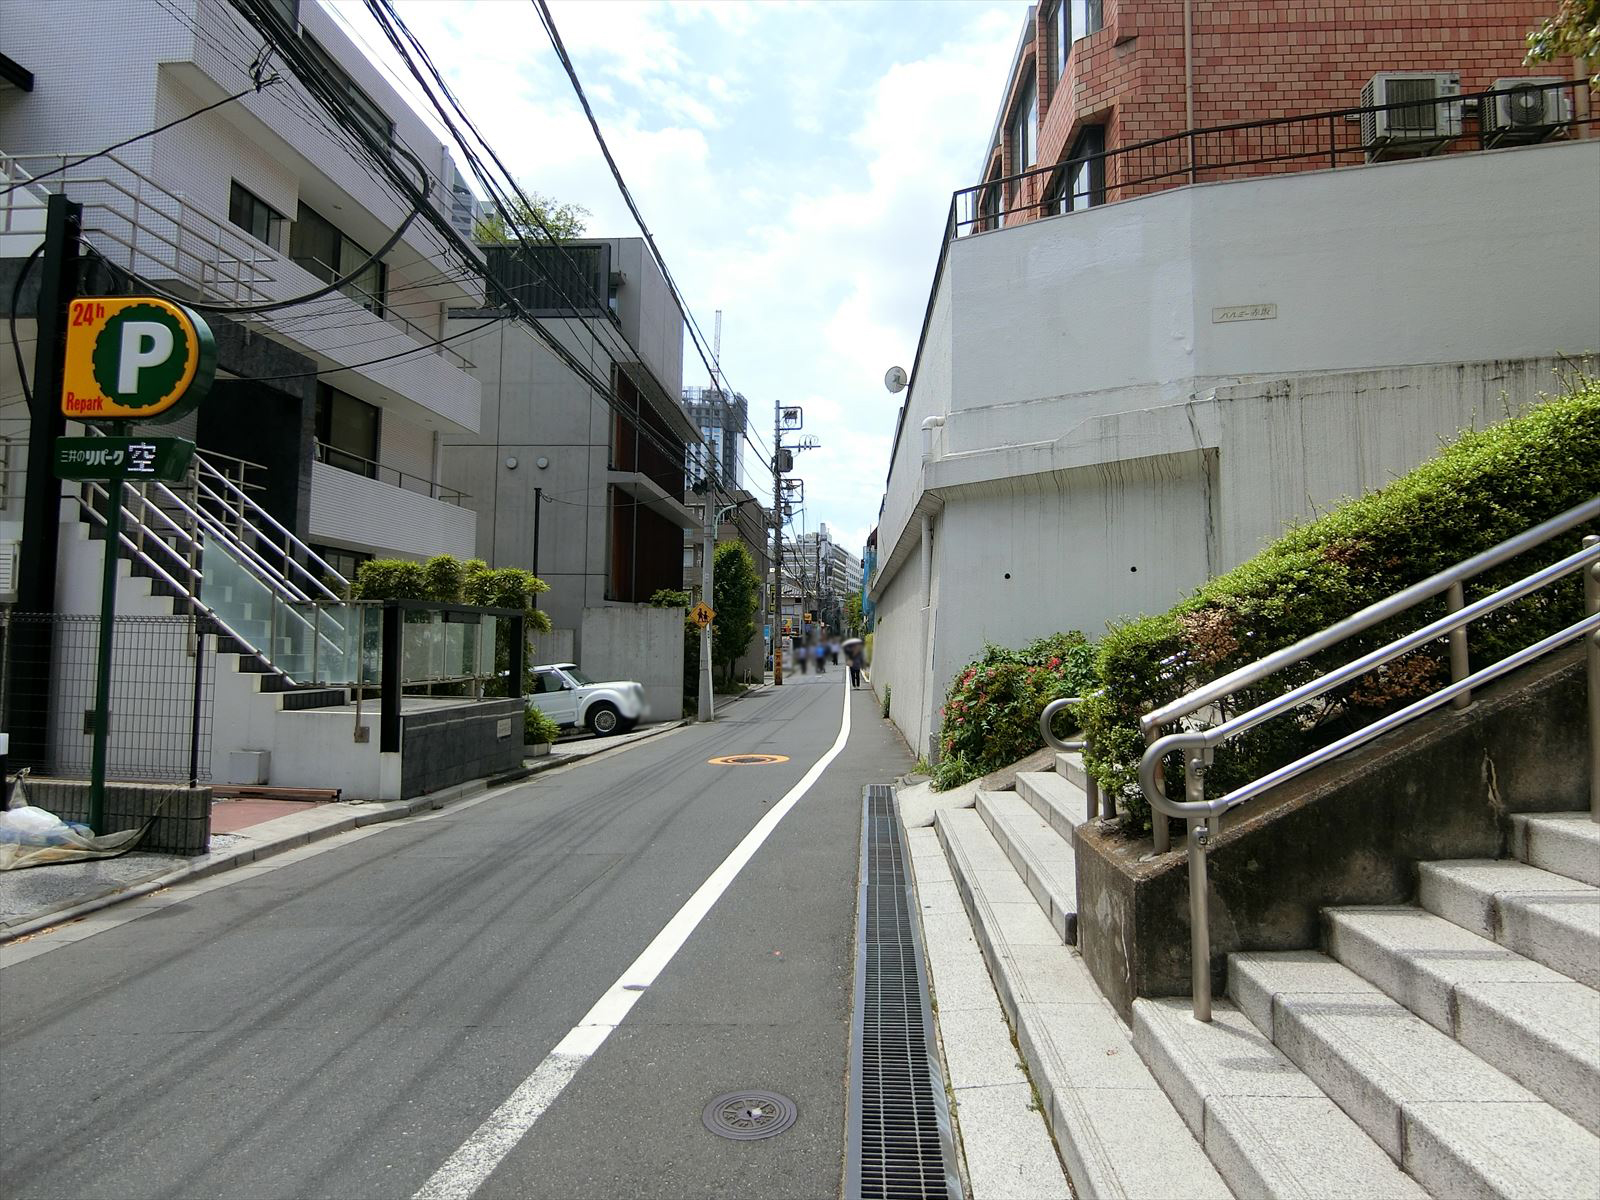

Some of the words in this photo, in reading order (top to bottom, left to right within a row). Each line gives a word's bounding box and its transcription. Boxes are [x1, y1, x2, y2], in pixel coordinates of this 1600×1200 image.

[73, 303, 105, 326] 24h
[118, 321, 174, 394] P
[66, 392, 103, 412] Repark
[61, 449, 124, 466] 三井のリパーク
[127, 442, 156, 472] 空
